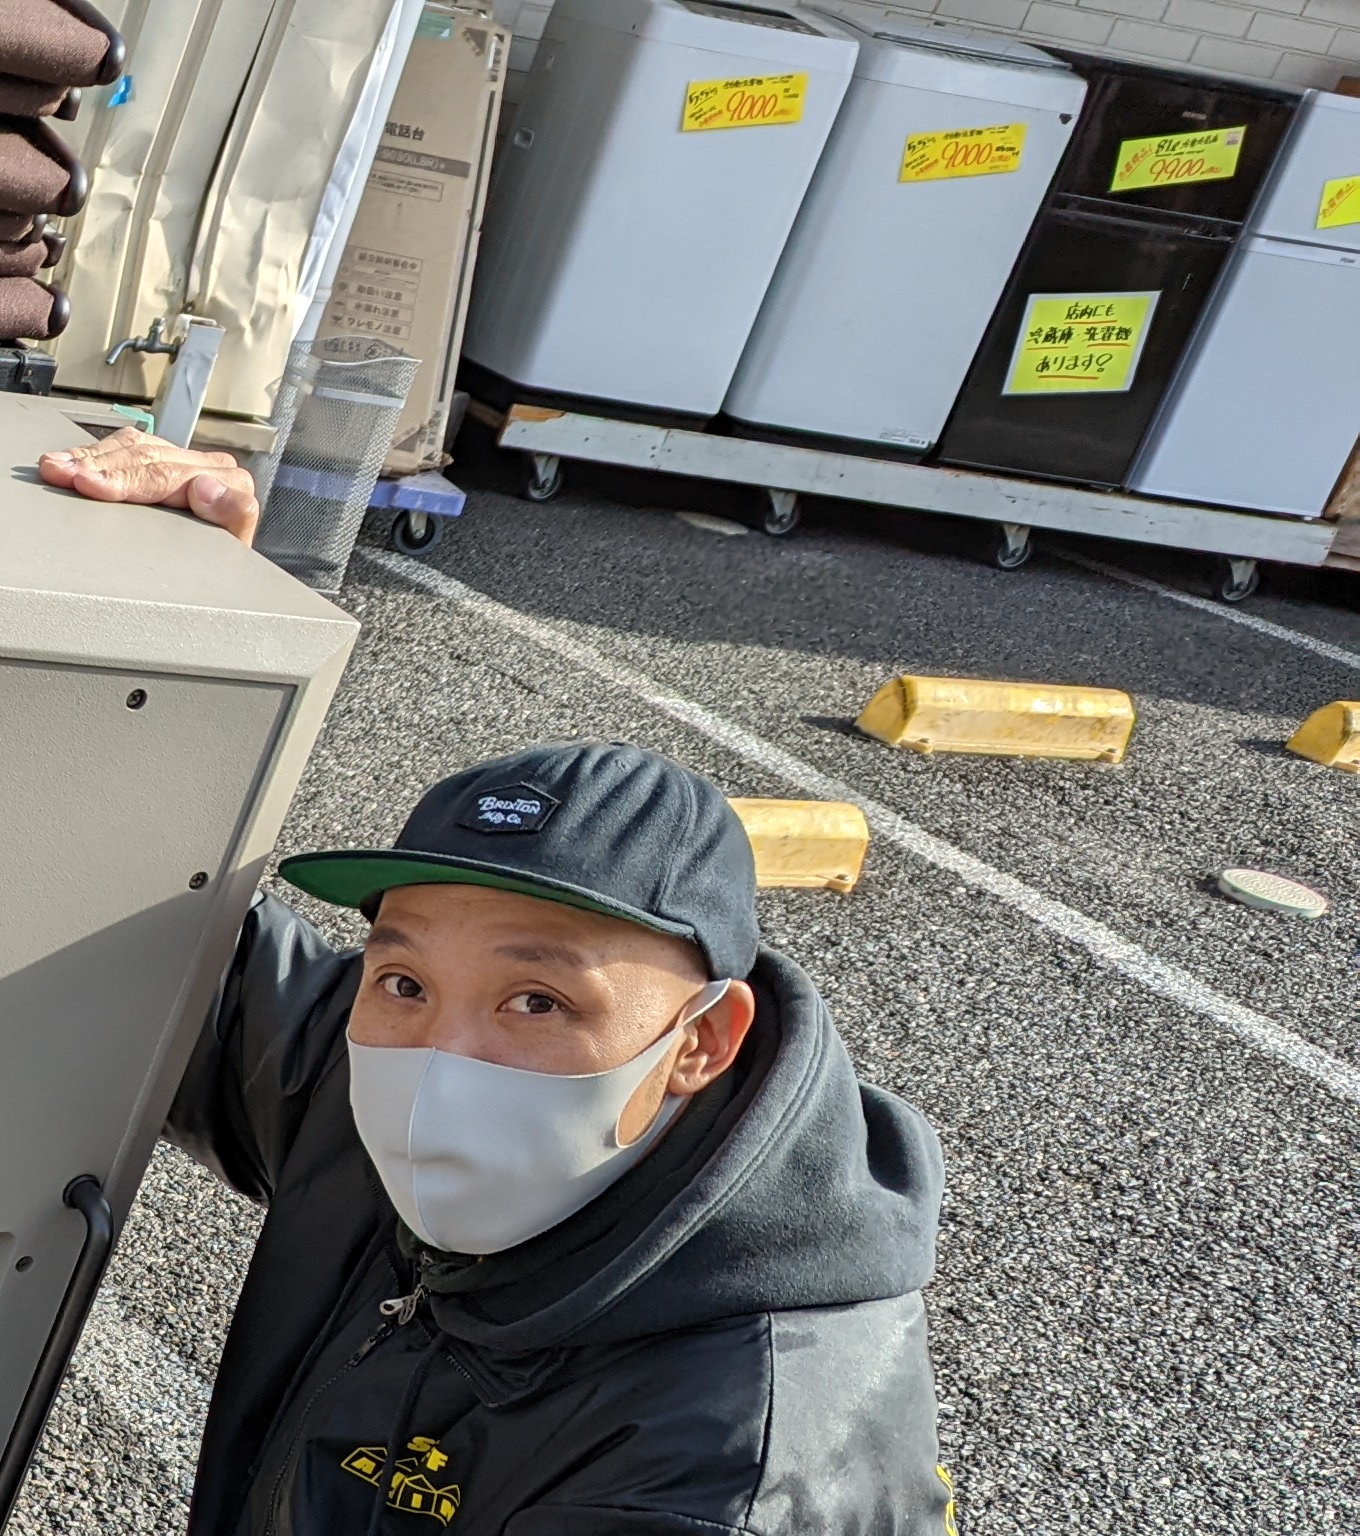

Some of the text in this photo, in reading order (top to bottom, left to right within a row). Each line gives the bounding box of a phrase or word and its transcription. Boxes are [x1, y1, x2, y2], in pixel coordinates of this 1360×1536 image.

[726, 90, 778, 121] 9000
[941, 141, 993, 169] 9000
[1064, 301, 1116, 320] 店内にも
